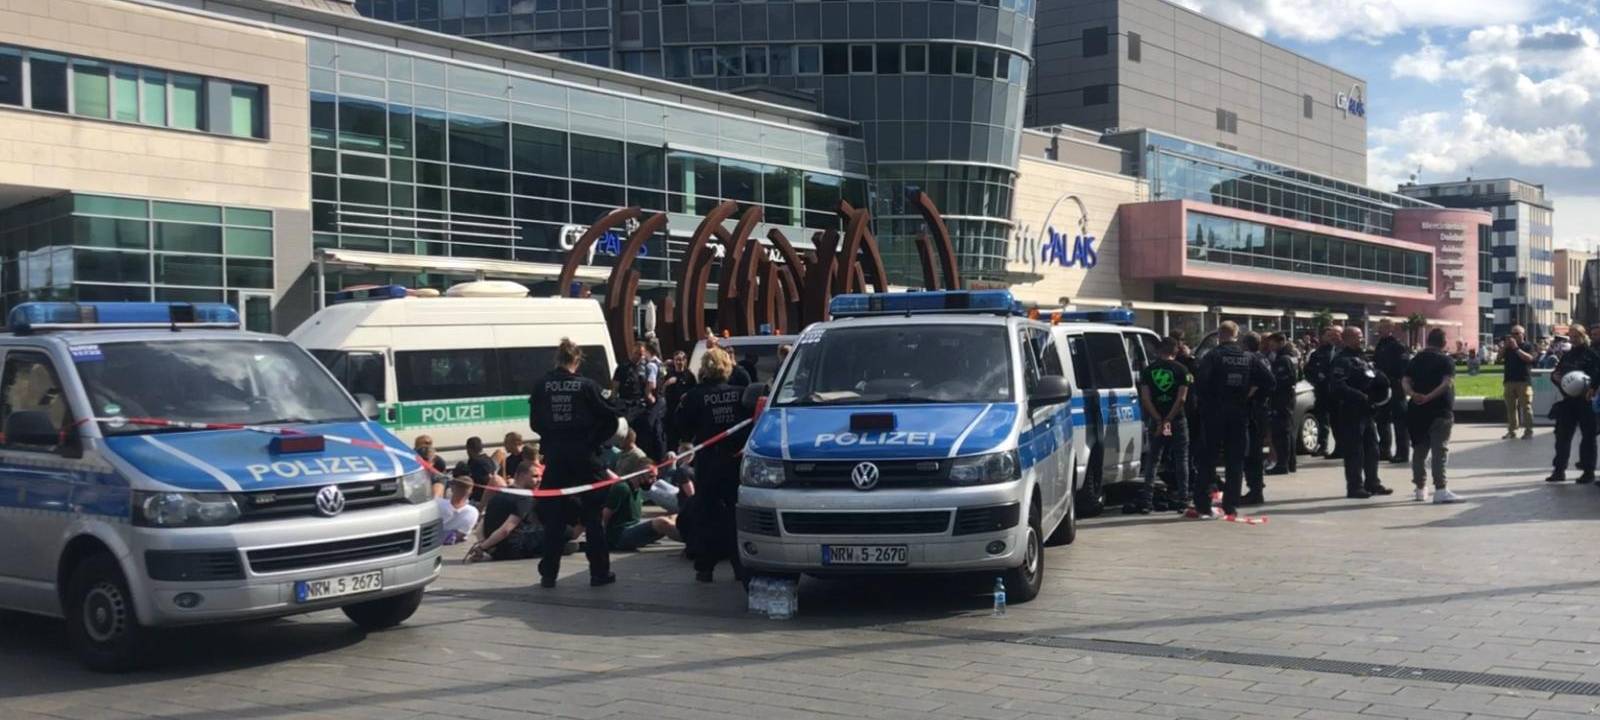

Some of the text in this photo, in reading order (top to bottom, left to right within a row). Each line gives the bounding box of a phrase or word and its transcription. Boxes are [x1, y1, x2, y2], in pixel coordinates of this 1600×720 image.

[1222, 355, 1249, 366] POLIZEI
[545, 381, 582, 392] POLIZEI
[704, 391, 740, 406] POLIZEI
[422, 404, 485, 422] POLIZEI
[815, 432, 936, 447] POLIZEI
[246, 456, 378, 481] POLIZEI
[831, 547, 854, 561] NRW
[306, 580, 331, 597] NRW
[351, 573, 381, 591] 2673
